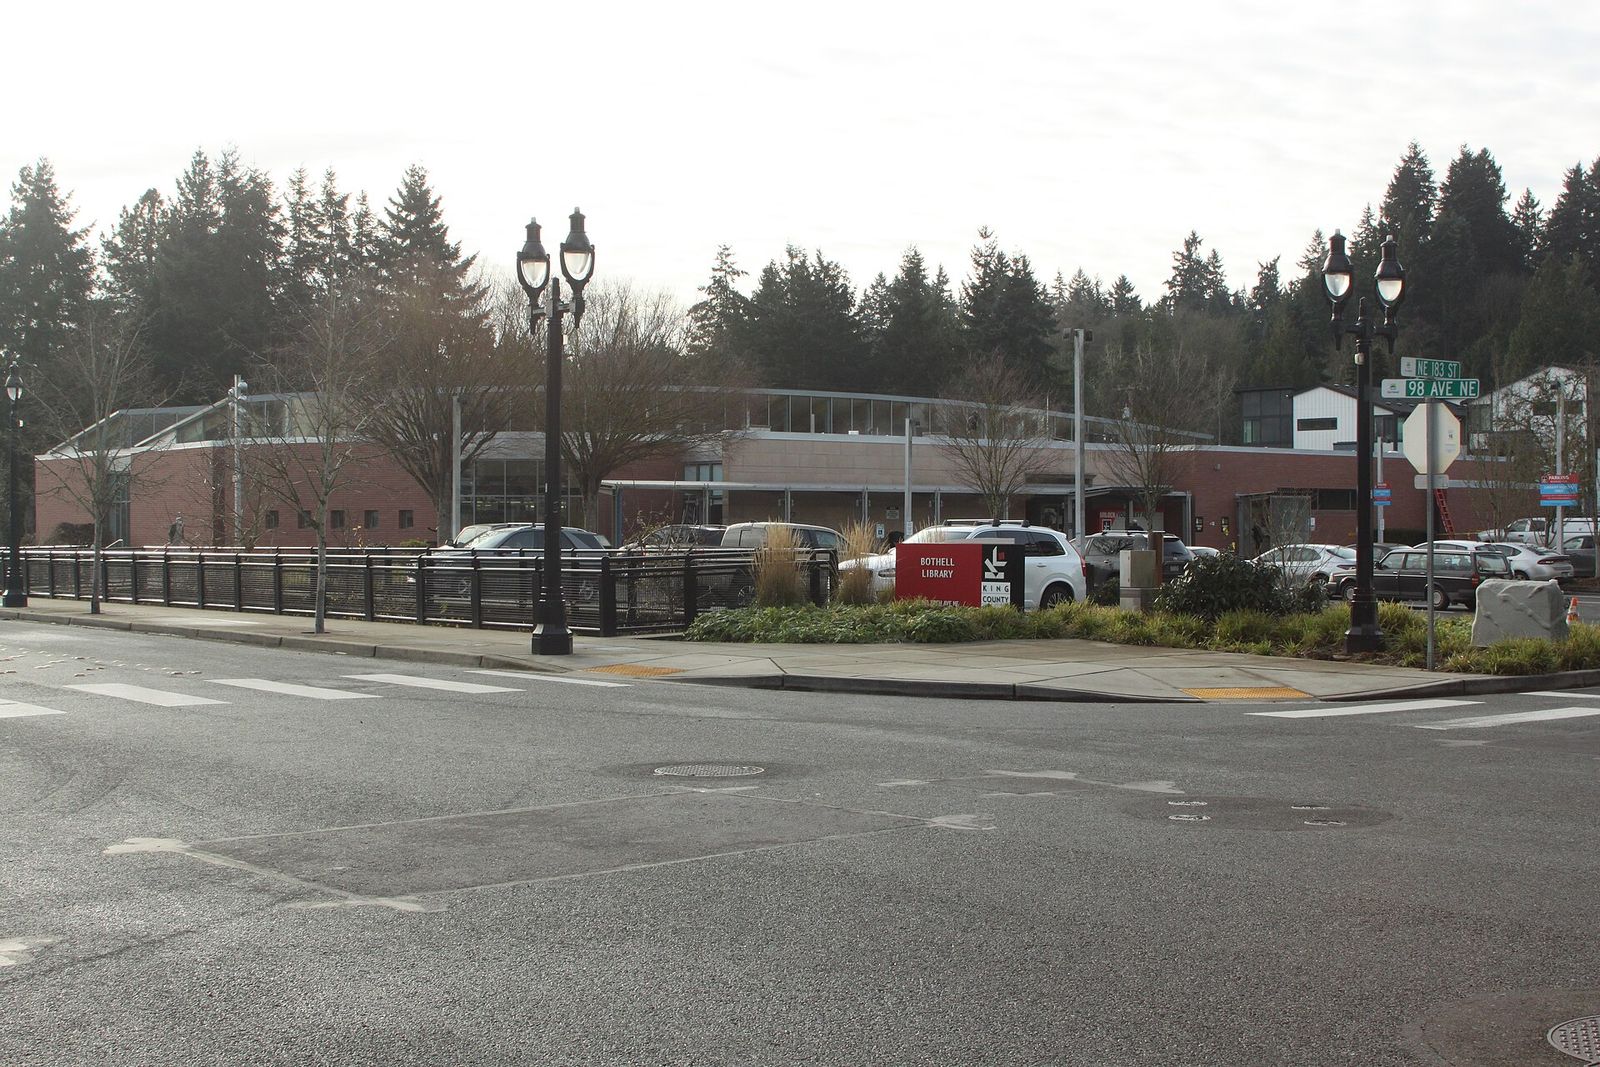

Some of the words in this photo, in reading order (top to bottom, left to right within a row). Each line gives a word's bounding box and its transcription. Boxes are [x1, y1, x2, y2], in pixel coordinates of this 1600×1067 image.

[1417, 360, 1428, 376] NE
[1431, 361, 1445, 377] 183
[1447, 363, 1458, 379] ST
[1408, 381, 1425, 396] 98
[1430, 381, 1454, 396] AVE
[1459, 381, 1477, 396] NE
[920, 557, 955, 567] BOTHELL
[921, 569, 954, 578] LIBRARY
[982, 585, 1010, 593] KING
